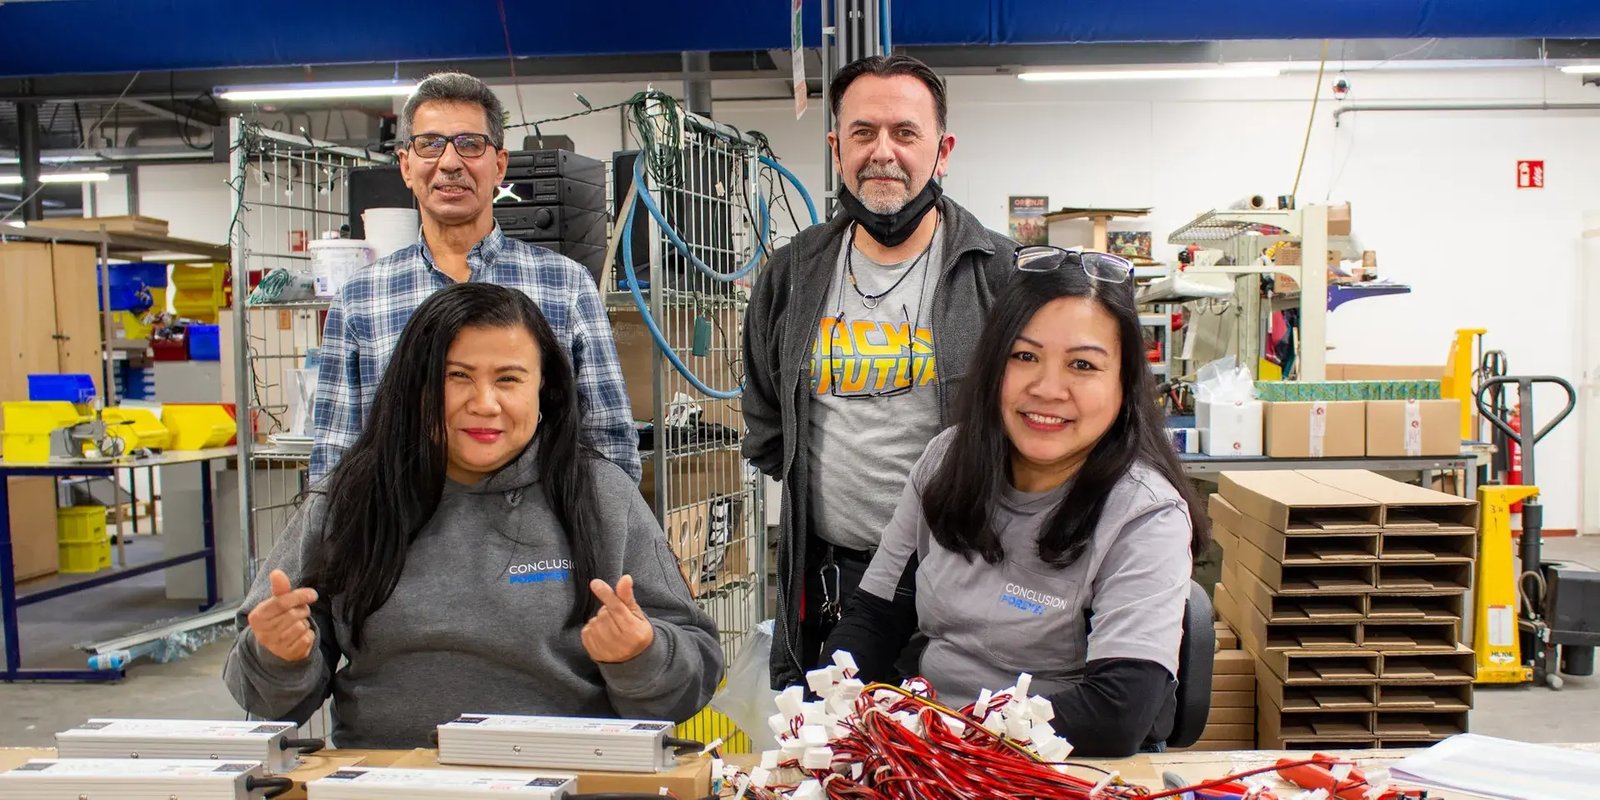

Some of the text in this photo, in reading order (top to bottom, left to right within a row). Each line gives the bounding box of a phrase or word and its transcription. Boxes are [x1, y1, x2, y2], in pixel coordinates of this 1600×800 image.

[812, 316, 933, 355] ACK
[817, 357, 938, 394] FUTU
[509, 559, 575, 574] CONCLUSI
[1005, 583, 1068, 609] CONCLUSION
